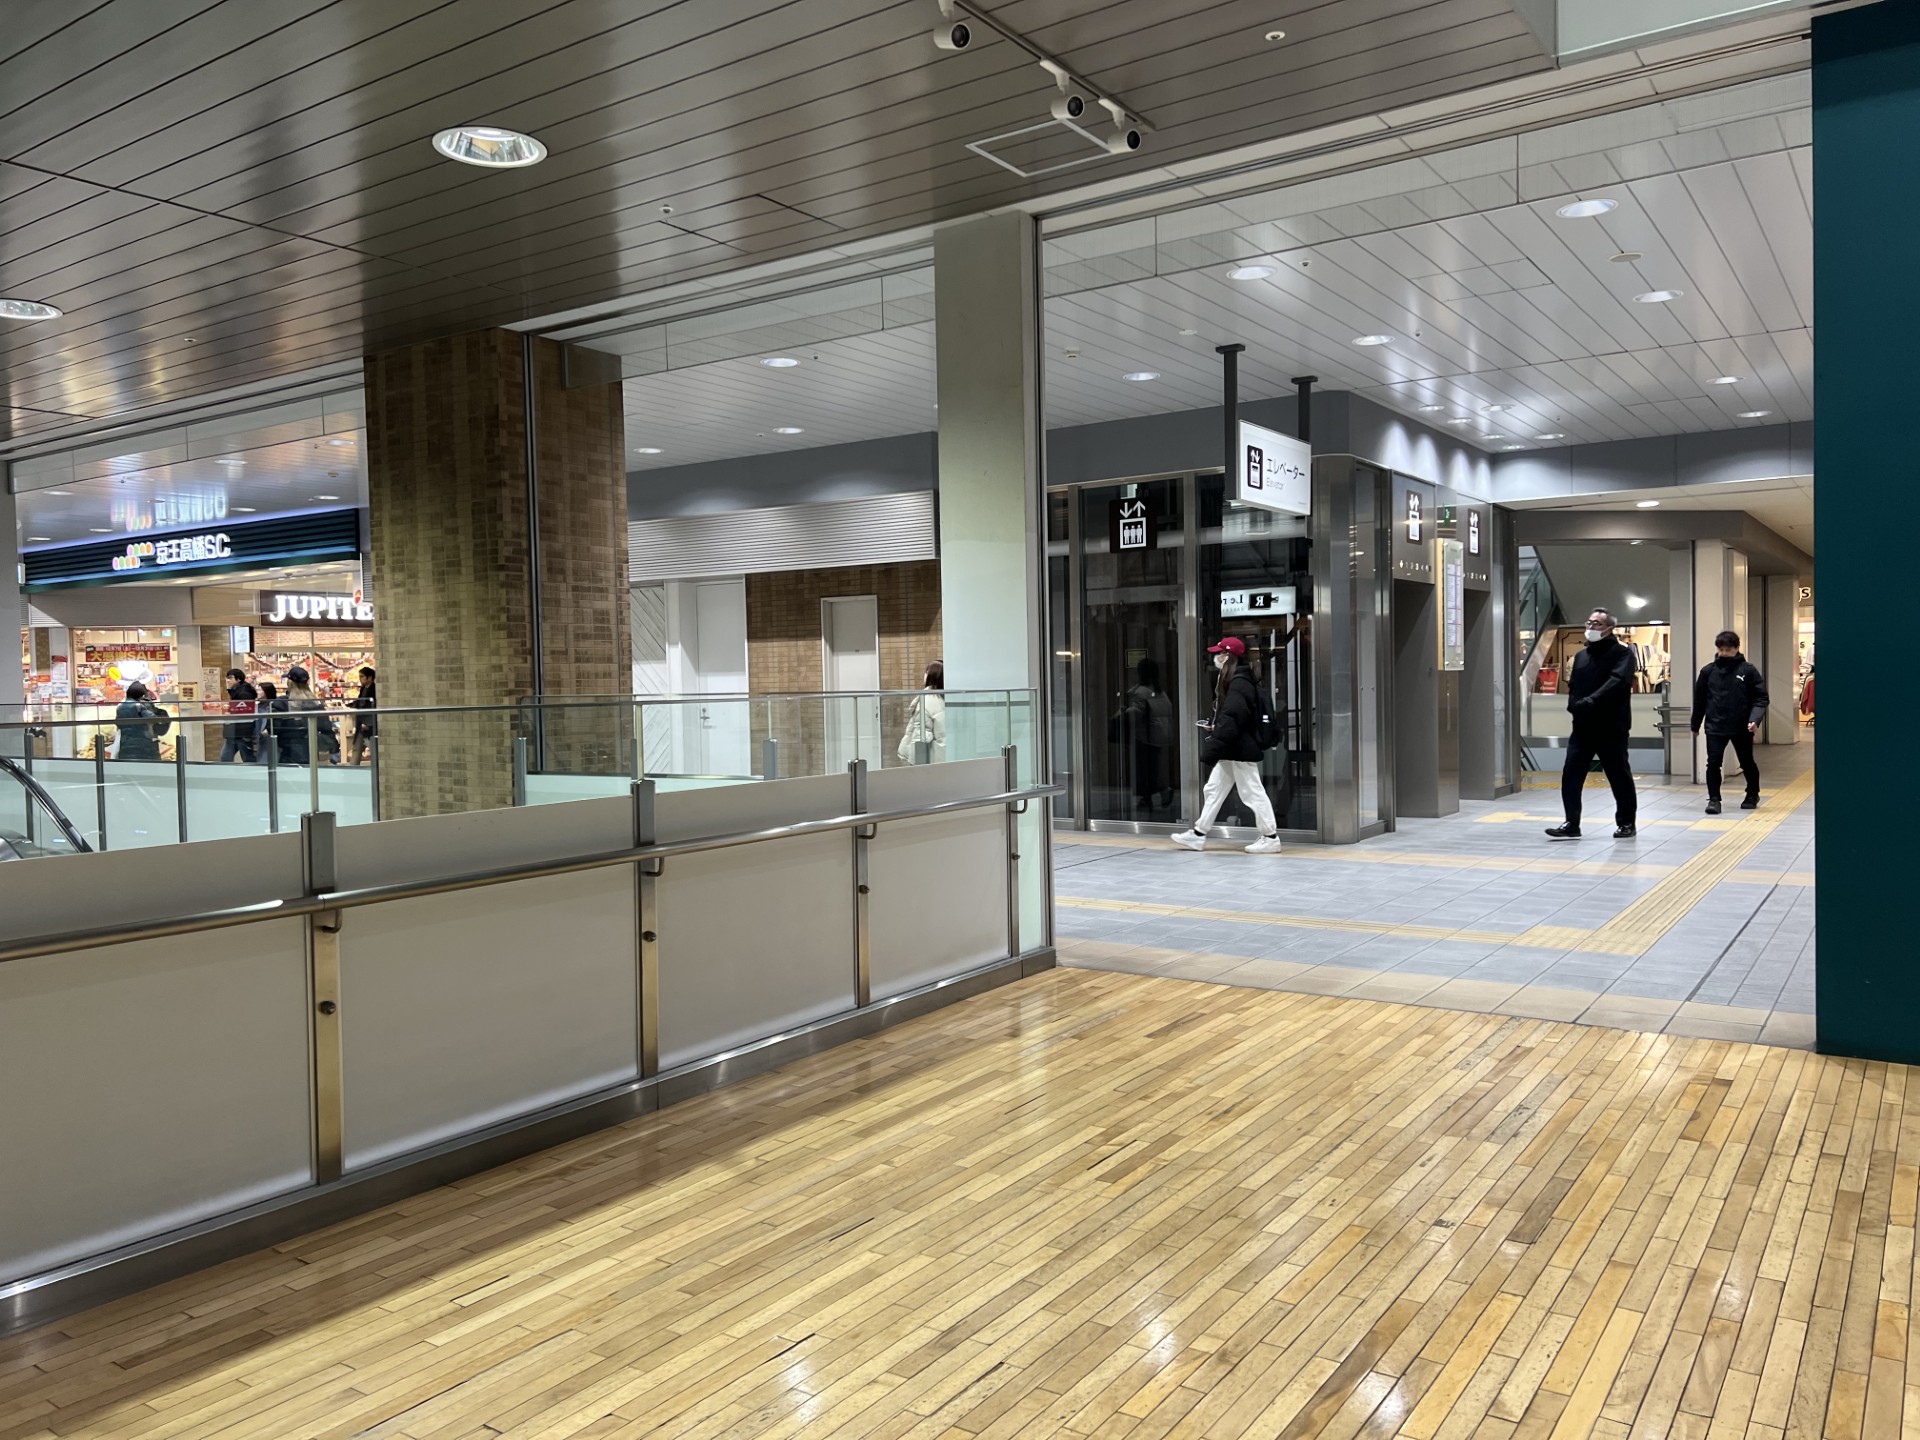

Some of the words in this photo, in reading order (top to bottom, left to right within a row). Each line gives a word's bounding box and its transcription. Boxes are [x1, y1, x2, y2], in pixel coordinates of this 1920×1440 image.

[1266, 457, 1306, 480] エレベーター
[155, 532, 231, 565] 京王高幡SC
[269, 594, 375, 623] JUPITE
